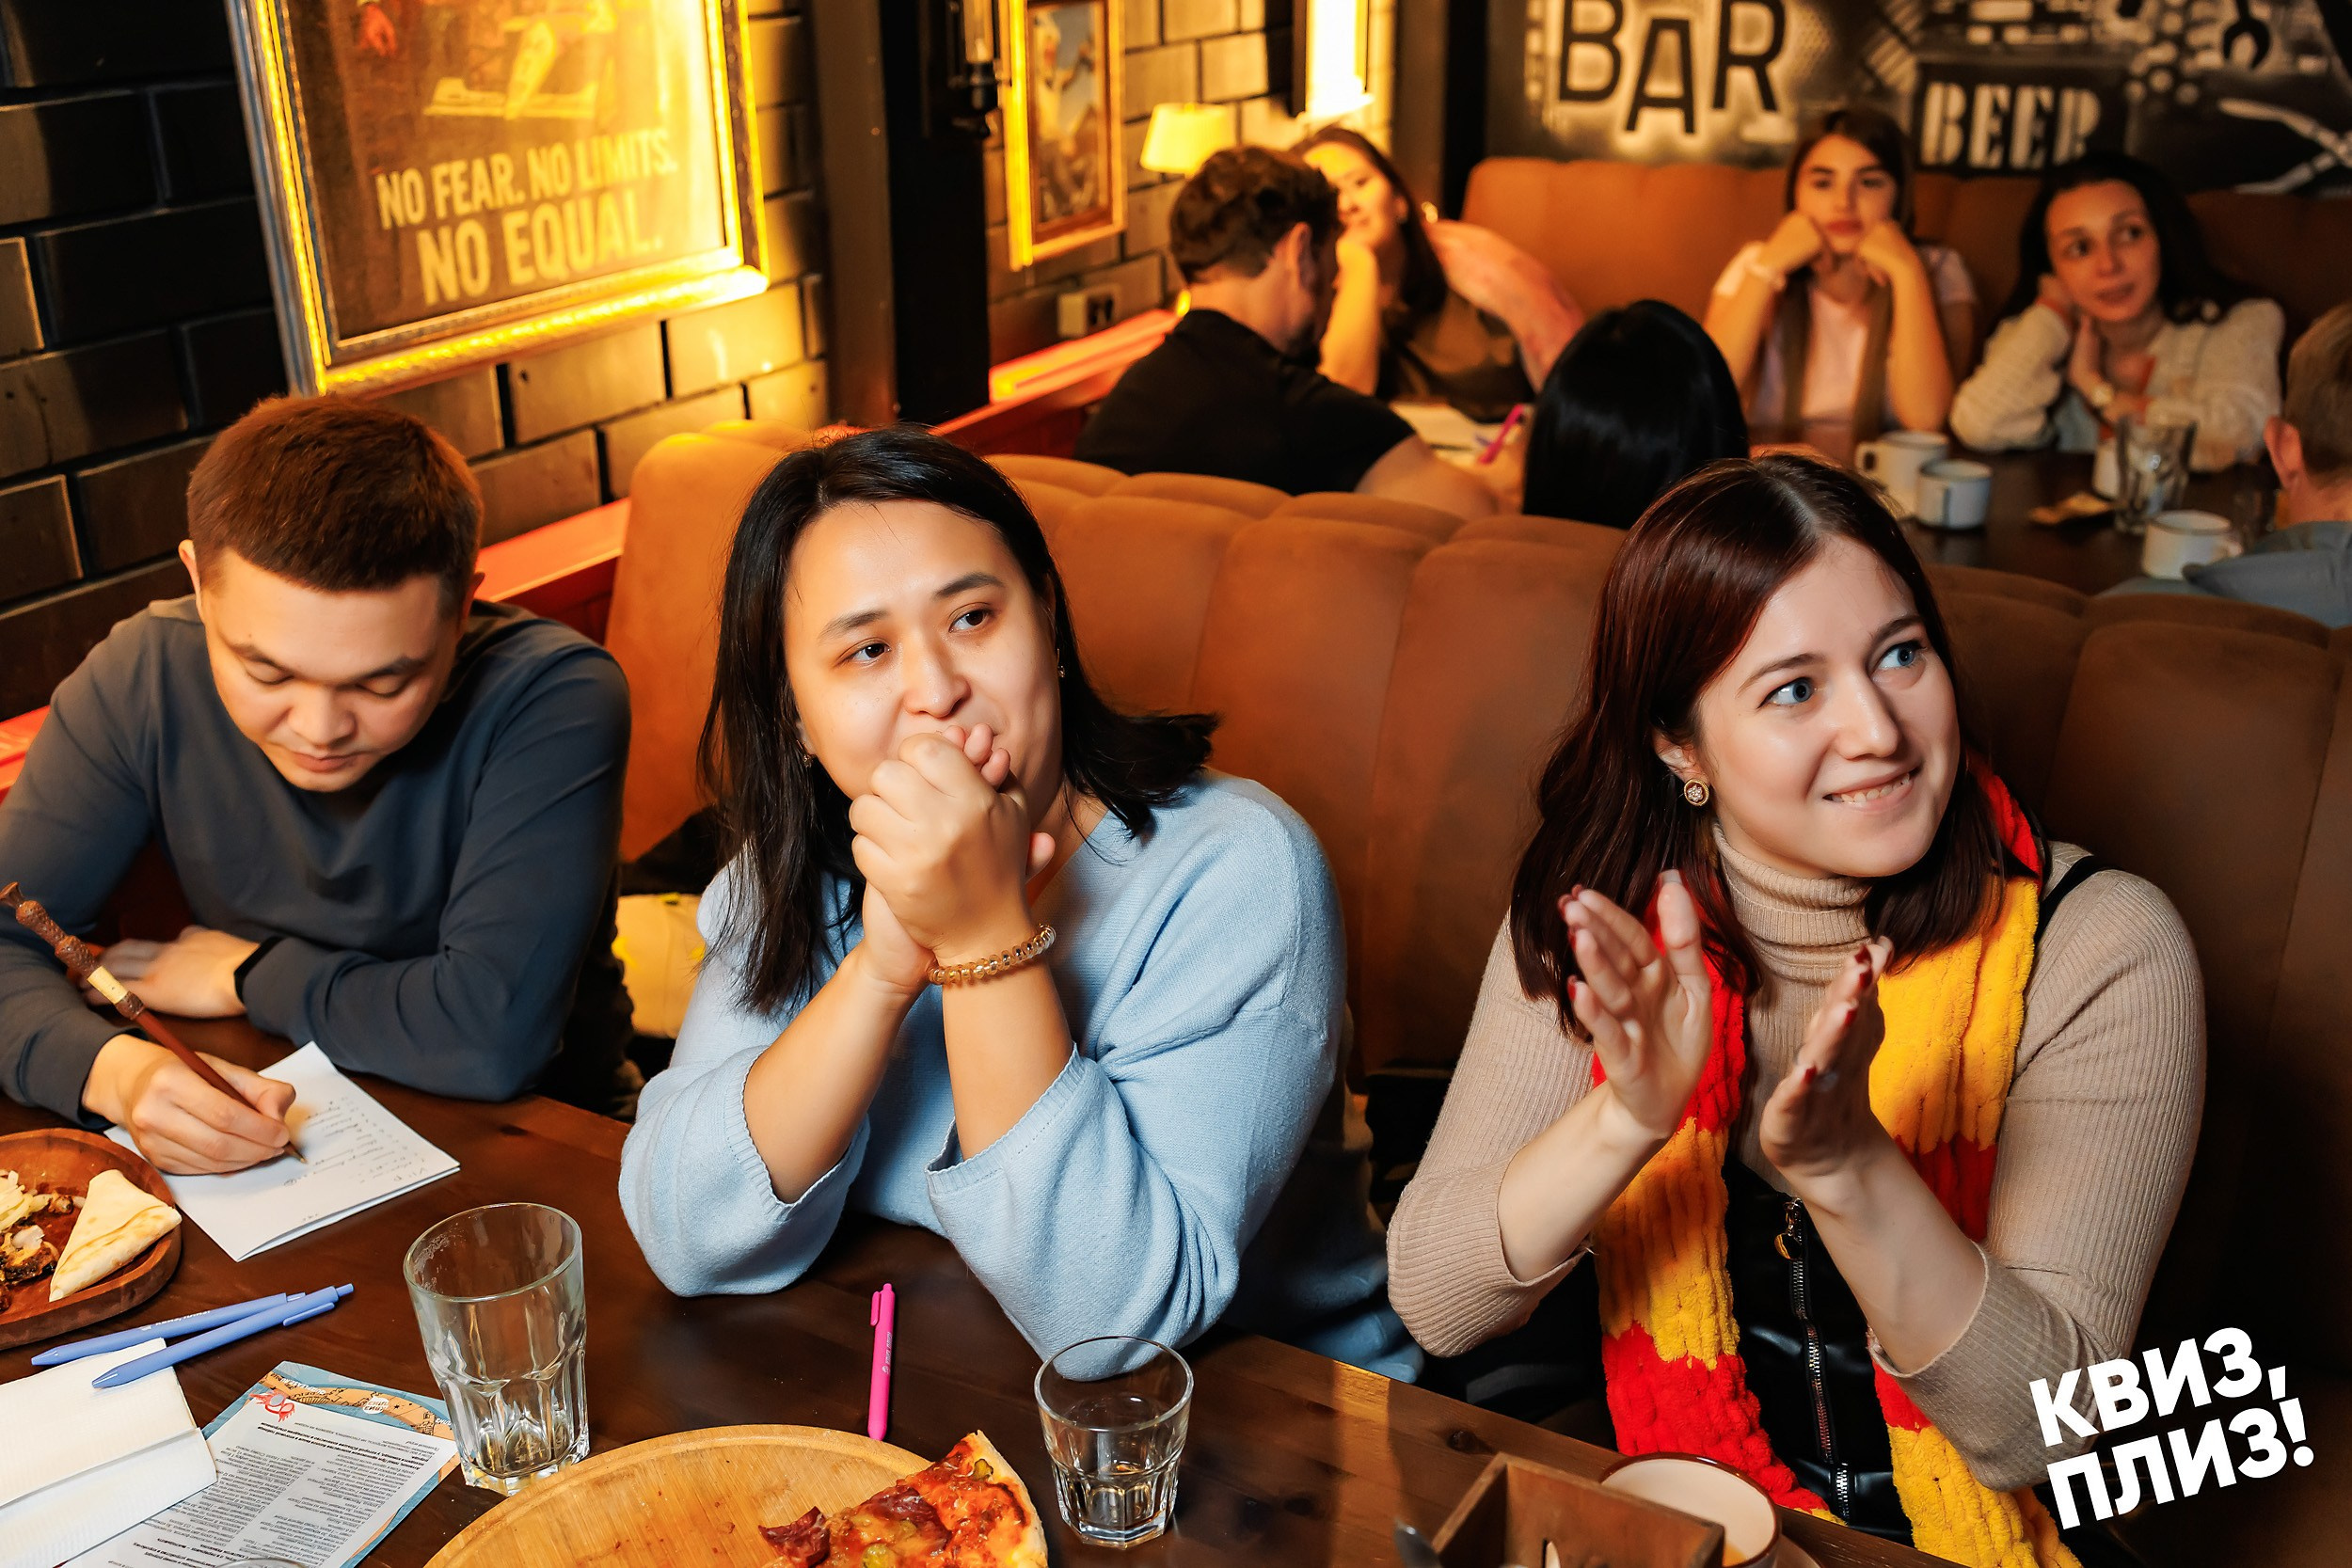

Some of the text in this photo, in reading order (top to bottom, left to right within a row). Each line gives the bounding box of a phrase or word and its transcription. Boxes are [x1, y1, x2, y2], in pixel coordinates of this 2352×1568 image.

[1559, 0, 1787, 134] BAR
[376, 127, 677, 230] NO FEAR. NO LIMITS.
[1920, 81, 2101, 169] BEER
[416, 189, 664, 307] NO EQUAL.
